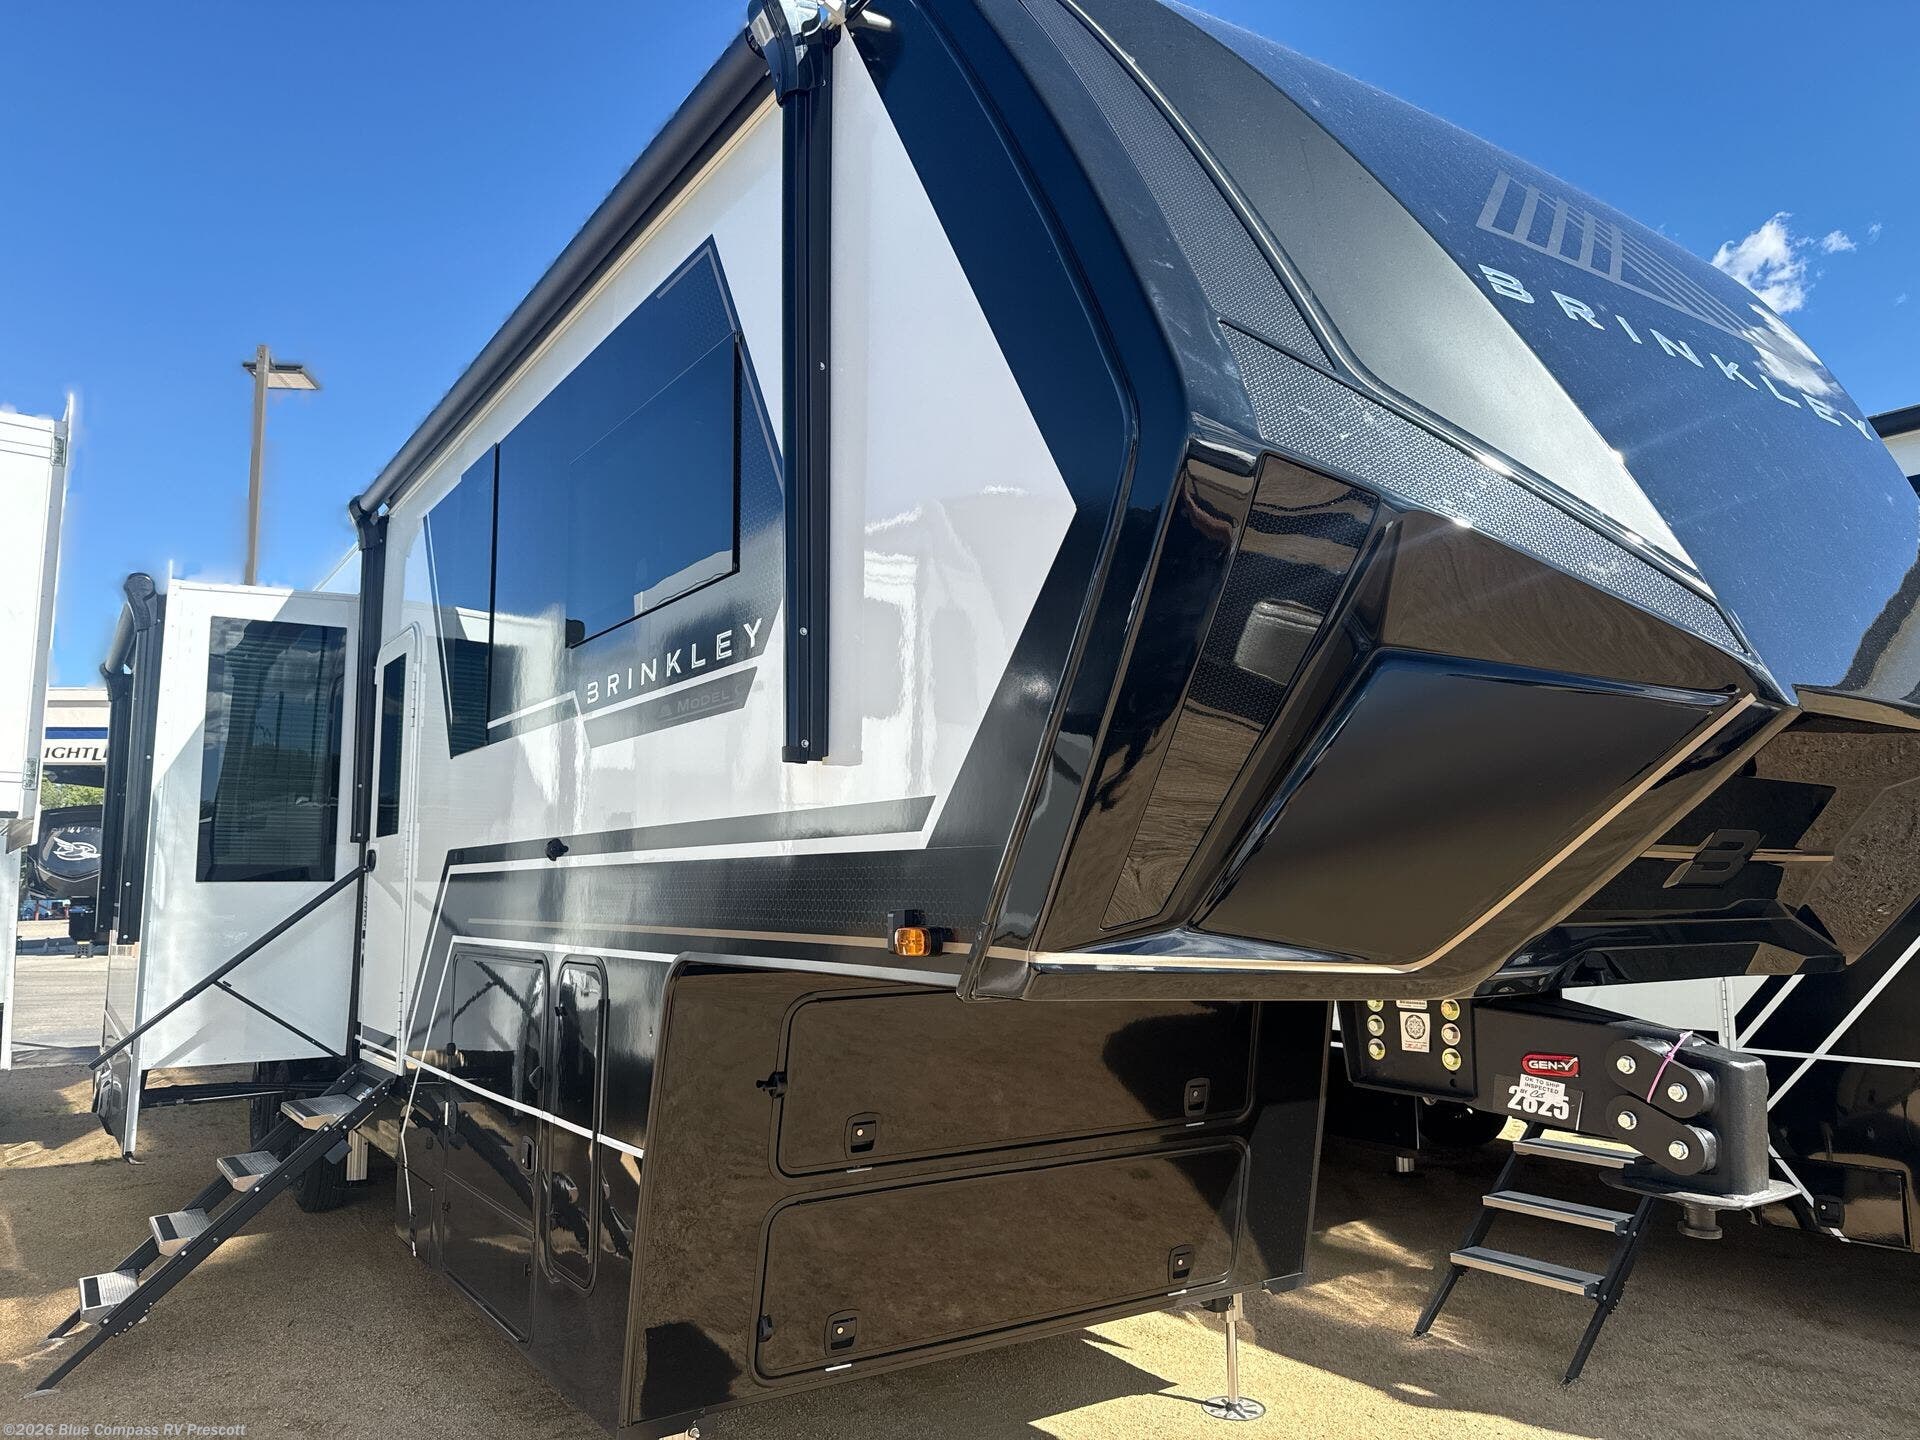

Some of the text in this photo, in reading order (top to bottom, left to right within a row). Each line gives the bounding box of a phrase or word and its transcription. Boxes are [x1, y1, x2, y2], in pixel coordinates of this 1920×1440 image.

[1477, 263, 1874, 442] BRINKLEY
[586, 617, 763, 705] BRINKLEY
[677, 689, 730, 713] MODEL
[1528, 1057, 1578, 1071] GEN-Y
[1524, 1082, 1559, 1095] INSPECTED
